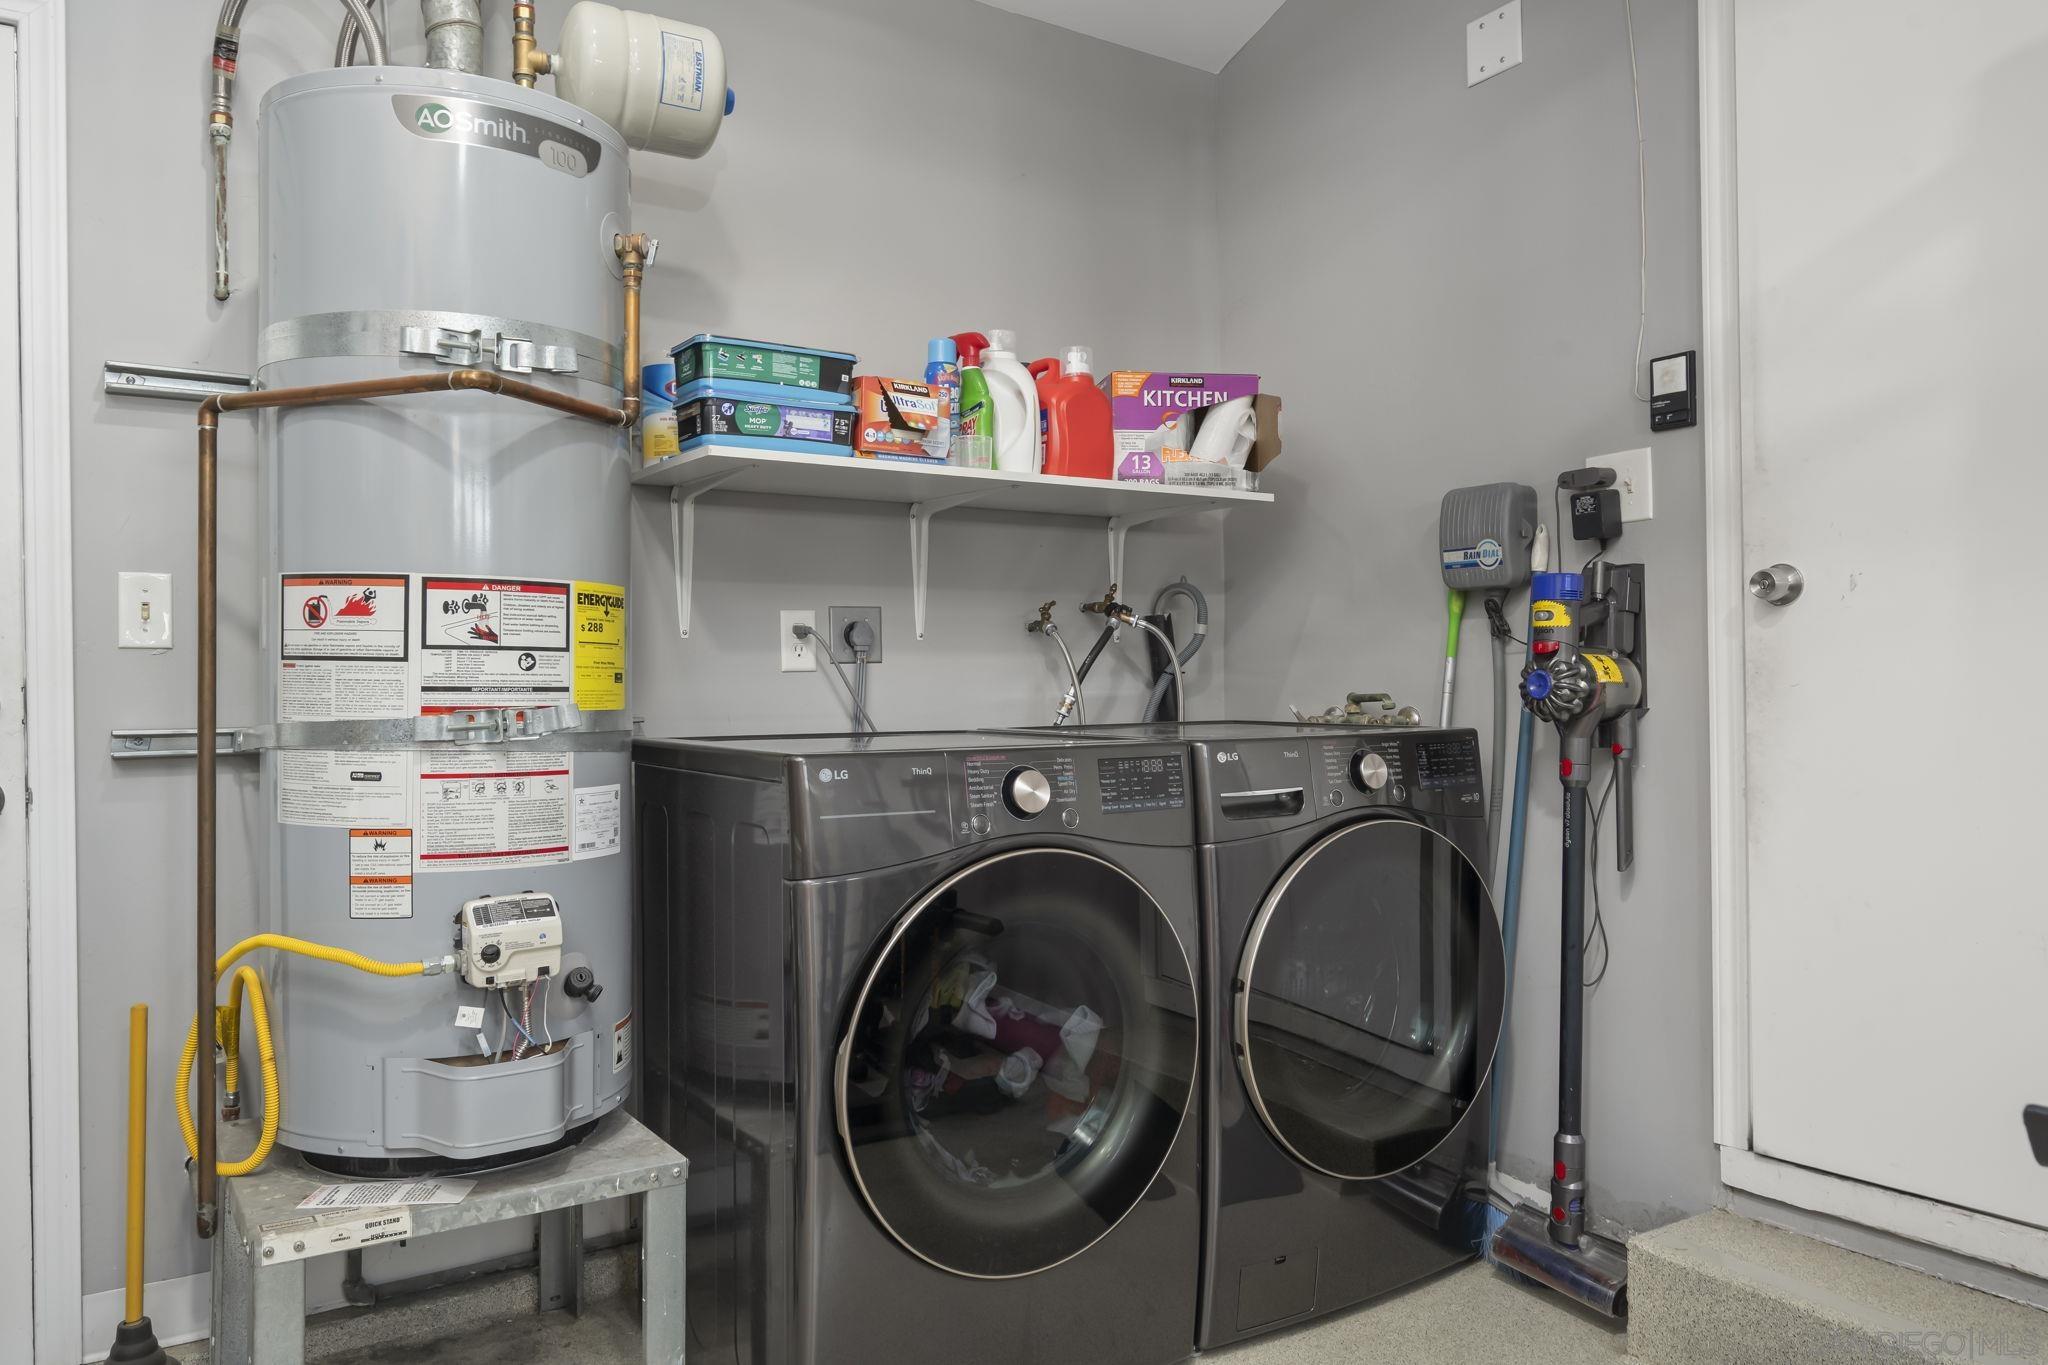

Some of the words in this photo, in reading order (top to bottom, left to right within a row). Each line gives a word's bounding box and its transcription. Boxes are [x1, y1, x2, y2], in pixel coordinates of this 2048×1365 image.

[694, 52, 703, 93] EASTMAN
[550, 146, 576, 171] 100
[893, 383, 928, 393] KIRKLAND
[1143, 390, 1228, 407] KITCHEN
[1132, 454, 1151, 470] 13
[588, 622, 603, 632] 288
[834, 770, 848, 780] LG
[364, 1220, 382, 1229] QUICK
